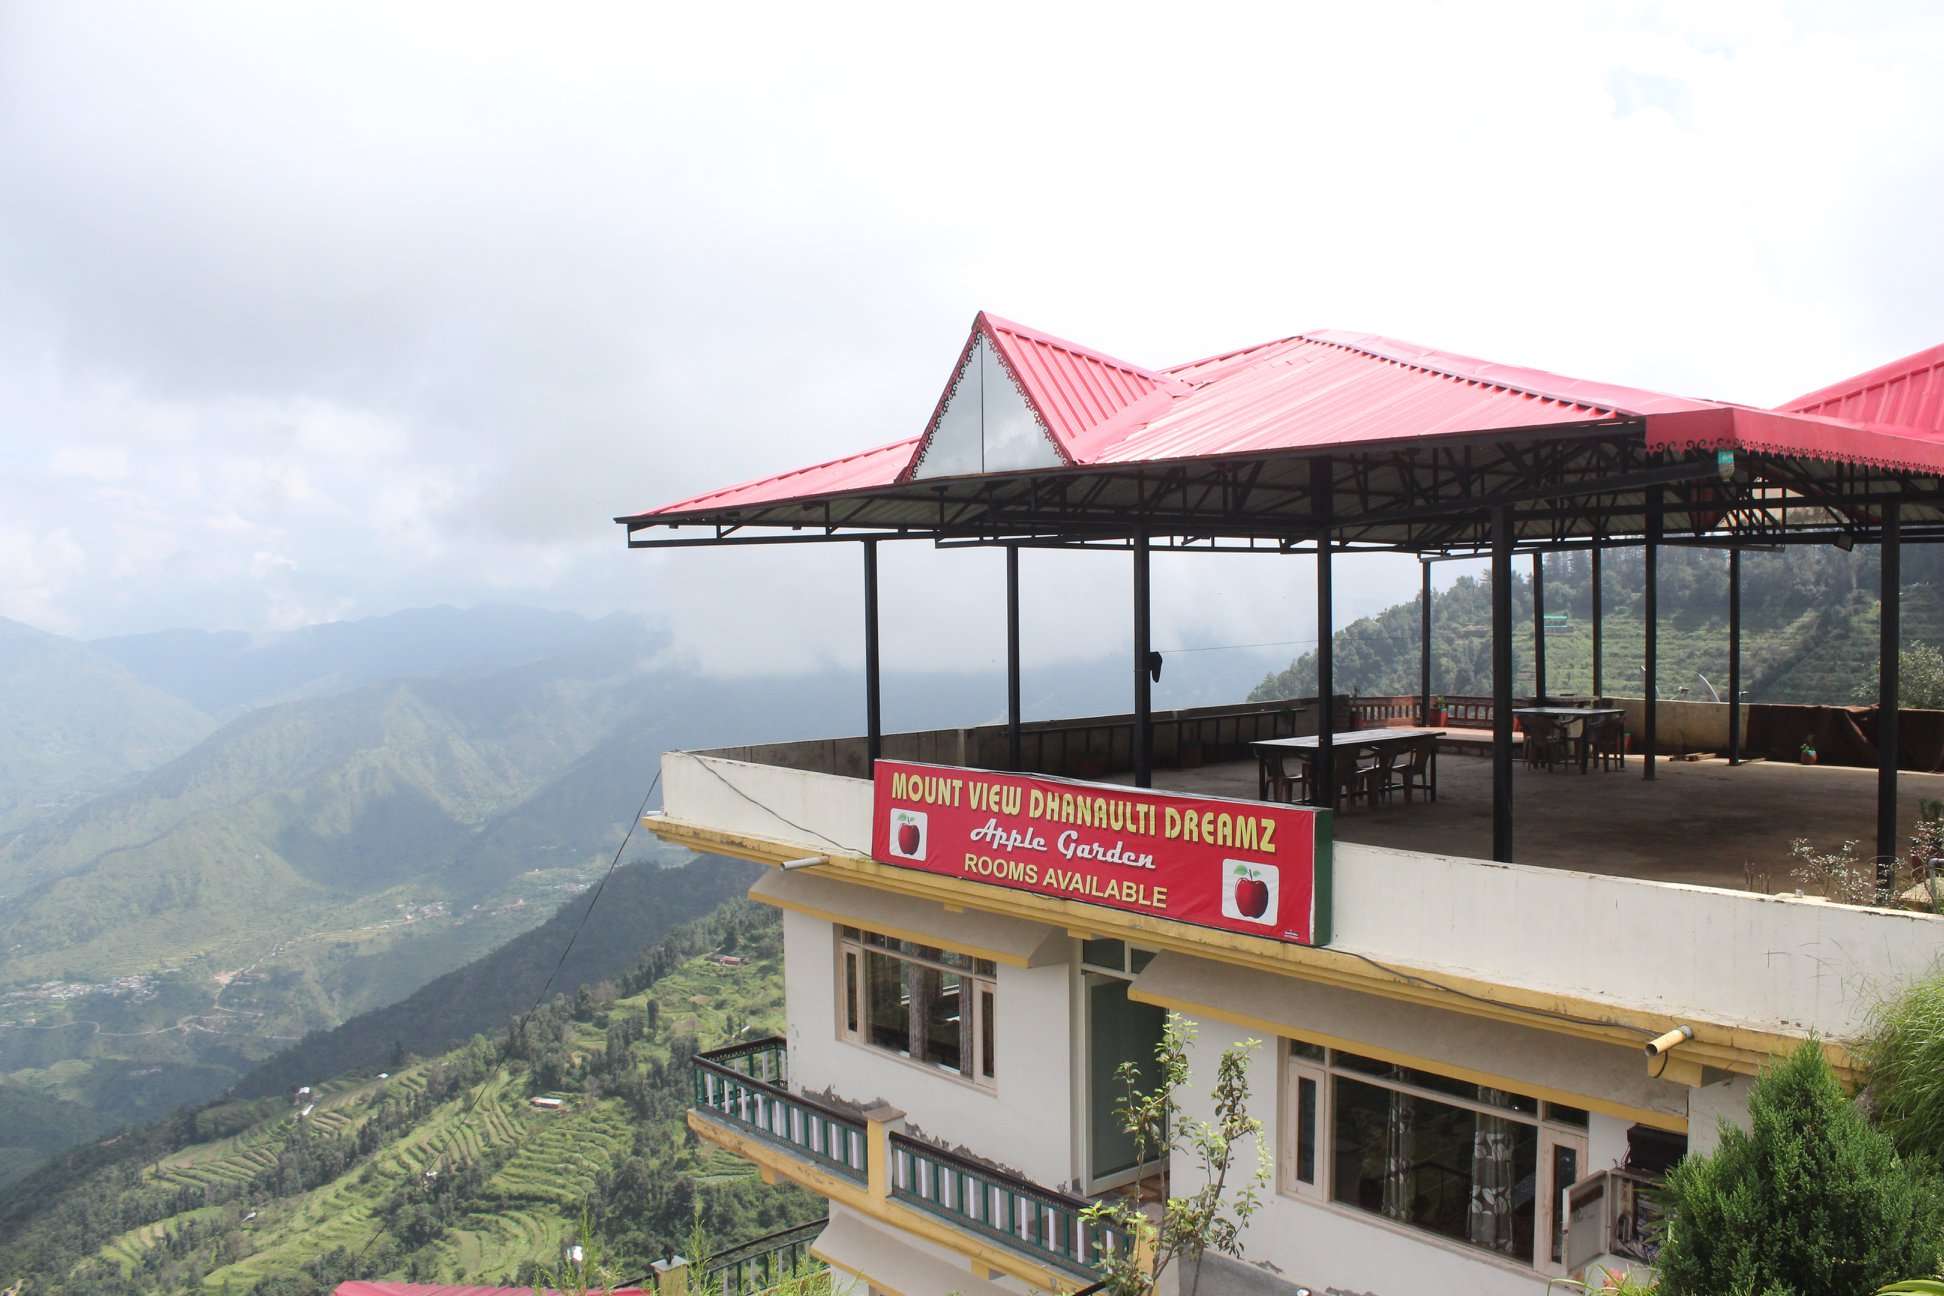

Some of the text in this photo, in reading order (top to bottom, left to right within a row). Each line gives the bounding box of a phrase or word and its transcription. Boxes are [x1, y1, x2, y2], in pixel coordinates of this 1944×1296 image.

[892, 772, 1275, 853] MOUNT VIEW DHANAULTI DREAMZ
[970, 818, 1156, 869] Apple Garden
[964, 853, 1168, 909] ROOMS AVAILABLE
